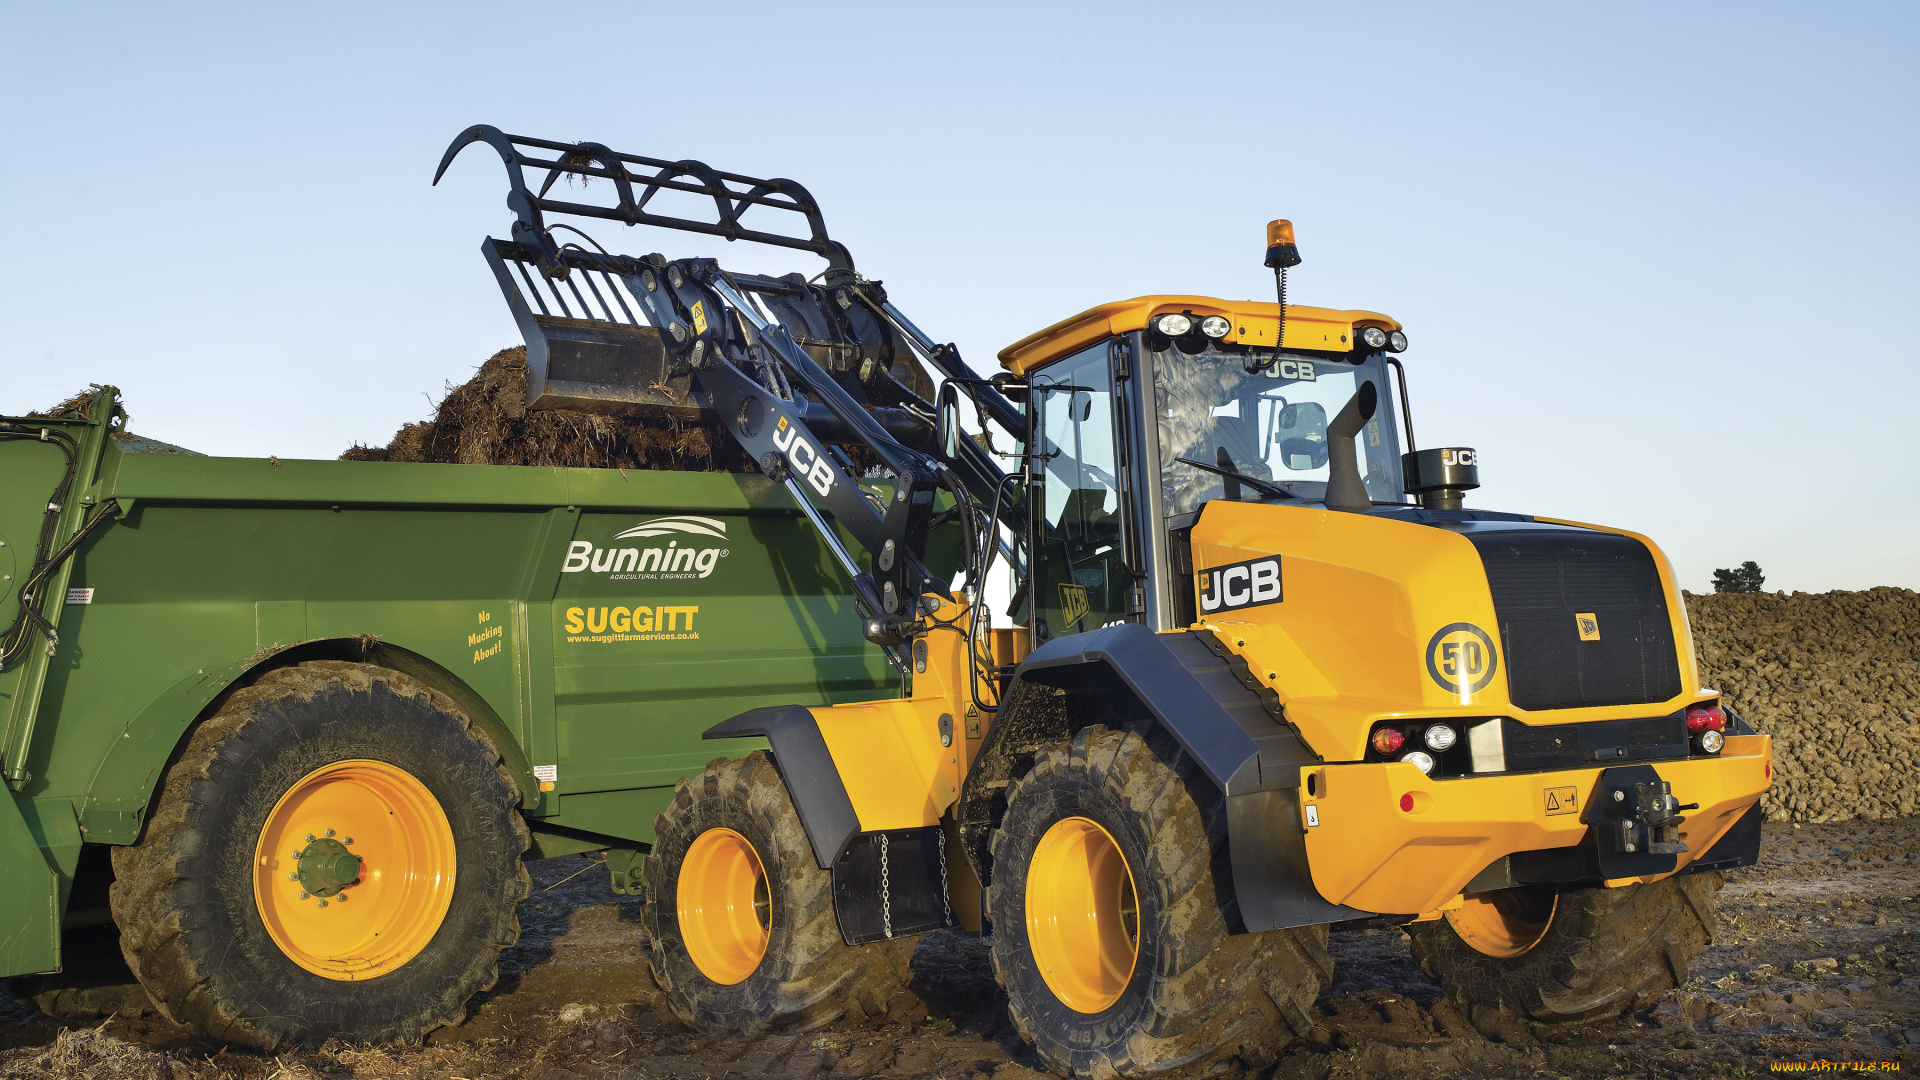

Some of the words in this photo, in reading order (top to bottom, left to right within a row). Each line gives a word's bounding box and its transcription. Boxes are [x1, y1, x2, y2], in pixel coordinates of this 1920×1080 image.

[1265, 361, 1315, 380] JCB
[773, 426, 835, 497] JCB
[1201, 560, 1280, 610] JCB
[479, 610, 490, 624] No
[1063, 587, 1087, 623] JCB
[565, 606, 699, 634] SUGGITT
[468, 625, 502, 647] Mucking
[567, 633, 700, 644] www.suggittfarmservices.co.uk
[473, 640, 501, 664] About!
[1442, 641, 1482, 675] 50
